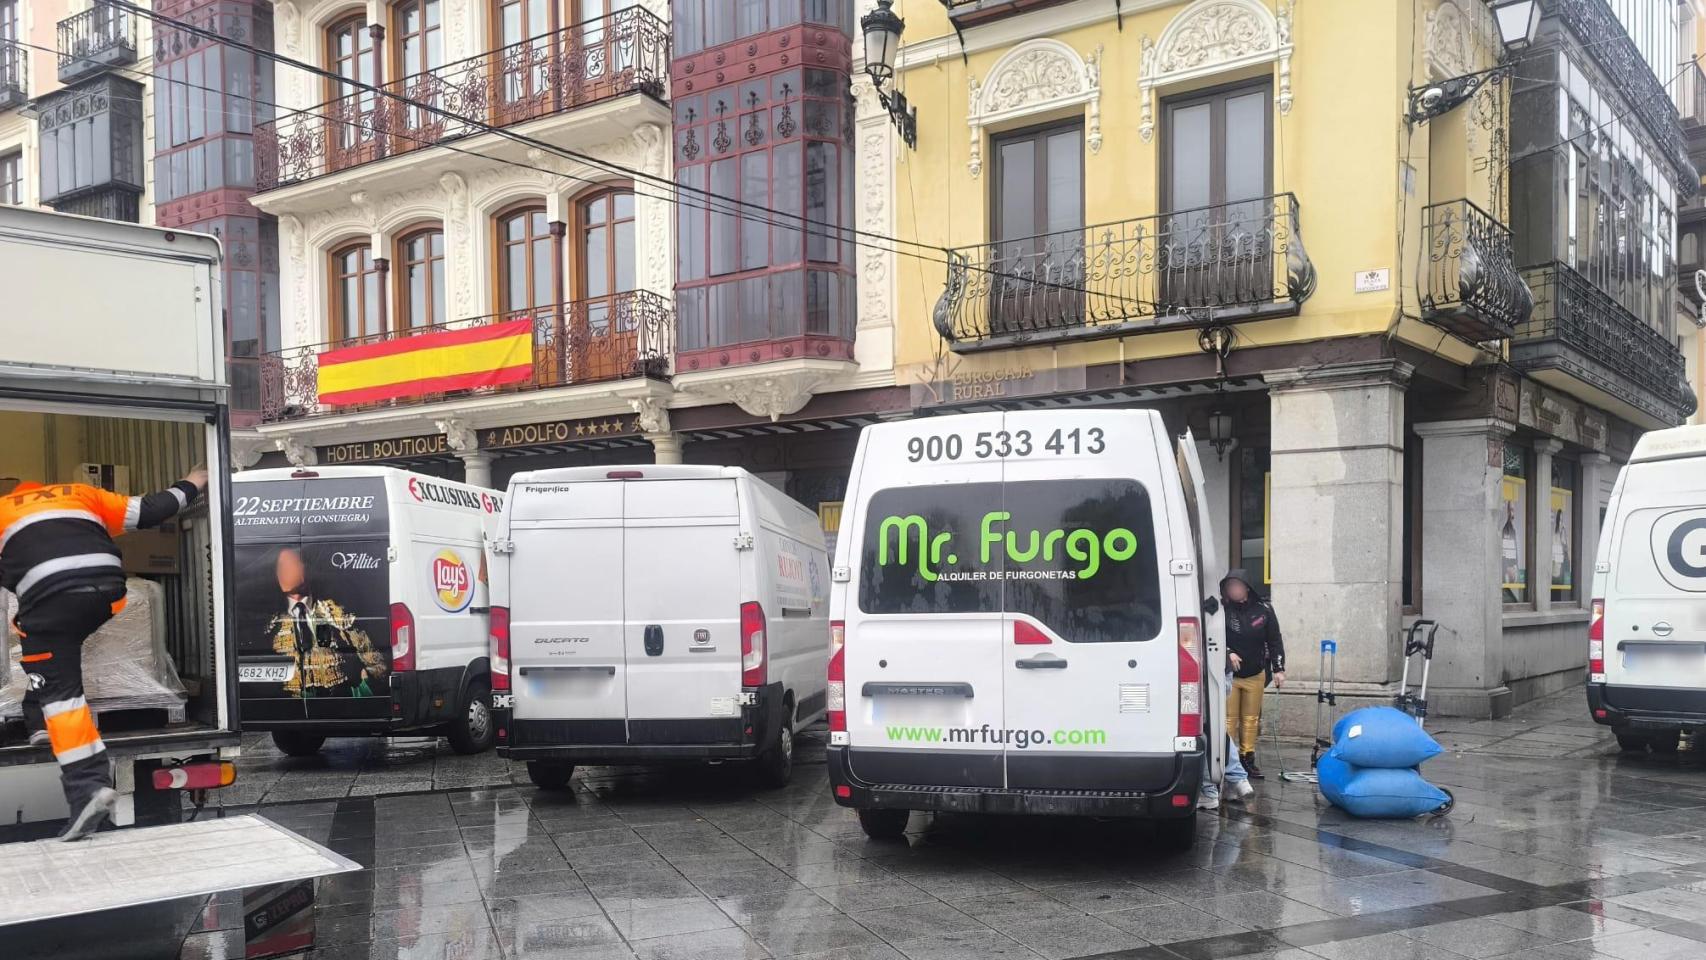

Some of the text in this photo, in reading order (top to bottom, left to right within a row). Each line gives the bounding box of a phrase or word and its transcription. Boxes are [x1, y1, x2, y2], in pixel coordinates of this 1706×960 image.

[953, 366, 1033, 386] EUROCAJA
[953, 383, 1005, 400] RURAL
[502, 422, 568, 445] ADOLFO
[327, 435, 446, 462] HOTEL BOUTIQUE
[907, 427, 1106, 462] 900 533 413
[408, 477, 481, 510] EXCLUSIVAS
[233, 495, 375, 516] 22 SEPTIEMBRE
[234, 515, 301, 526] ALTERNATIVA
[879, 511, 1138, 582] Mr. Furgo
[331, 551, 382, 569] Villita
[937, 569, 1077, 582] ALQUILER DE FURGONETAS
[264, 667, 285, 678] KHZ
[887, 687, 944, 696] MASTER
[886, 724, 1106, 749] www.mrfurgo.com
